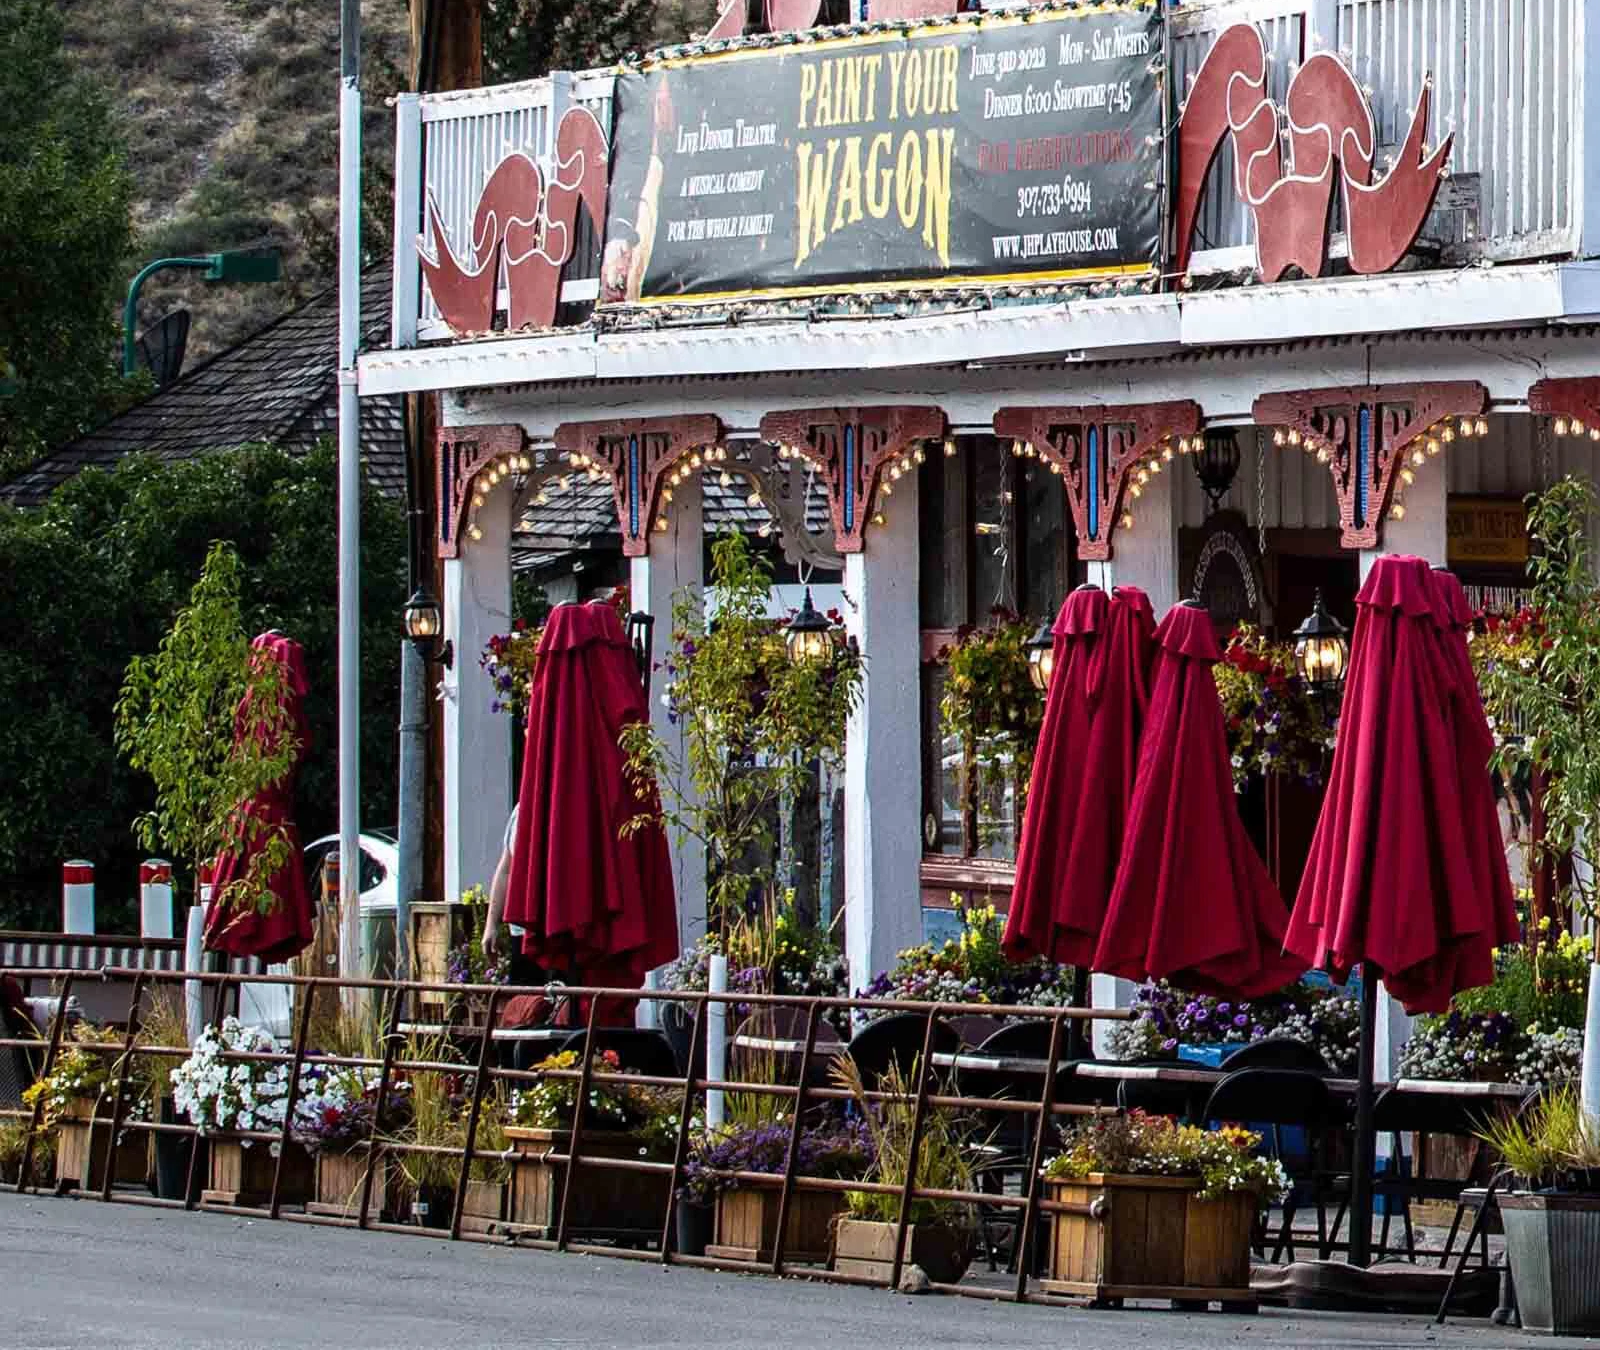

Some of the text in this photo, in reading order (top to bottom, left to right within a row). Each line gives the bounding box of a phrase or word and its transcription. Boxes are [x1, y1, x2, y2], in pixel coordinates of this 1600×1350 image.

[1018, 47, 1046, 72] 2022
[799, 44, 959, 130] PAINT YOUR
[1024, 84, 1051, 115] 6:00
[687, 173, 726, 196] MUSICAL
[726, 170, 764, 193] COMEDY
[794, 128, 956, 270] WAGON
[668, 221, 686, 242] FOR
[687, 219, 705, 240] THE
[706, 217, 737, 238] WHOLE
